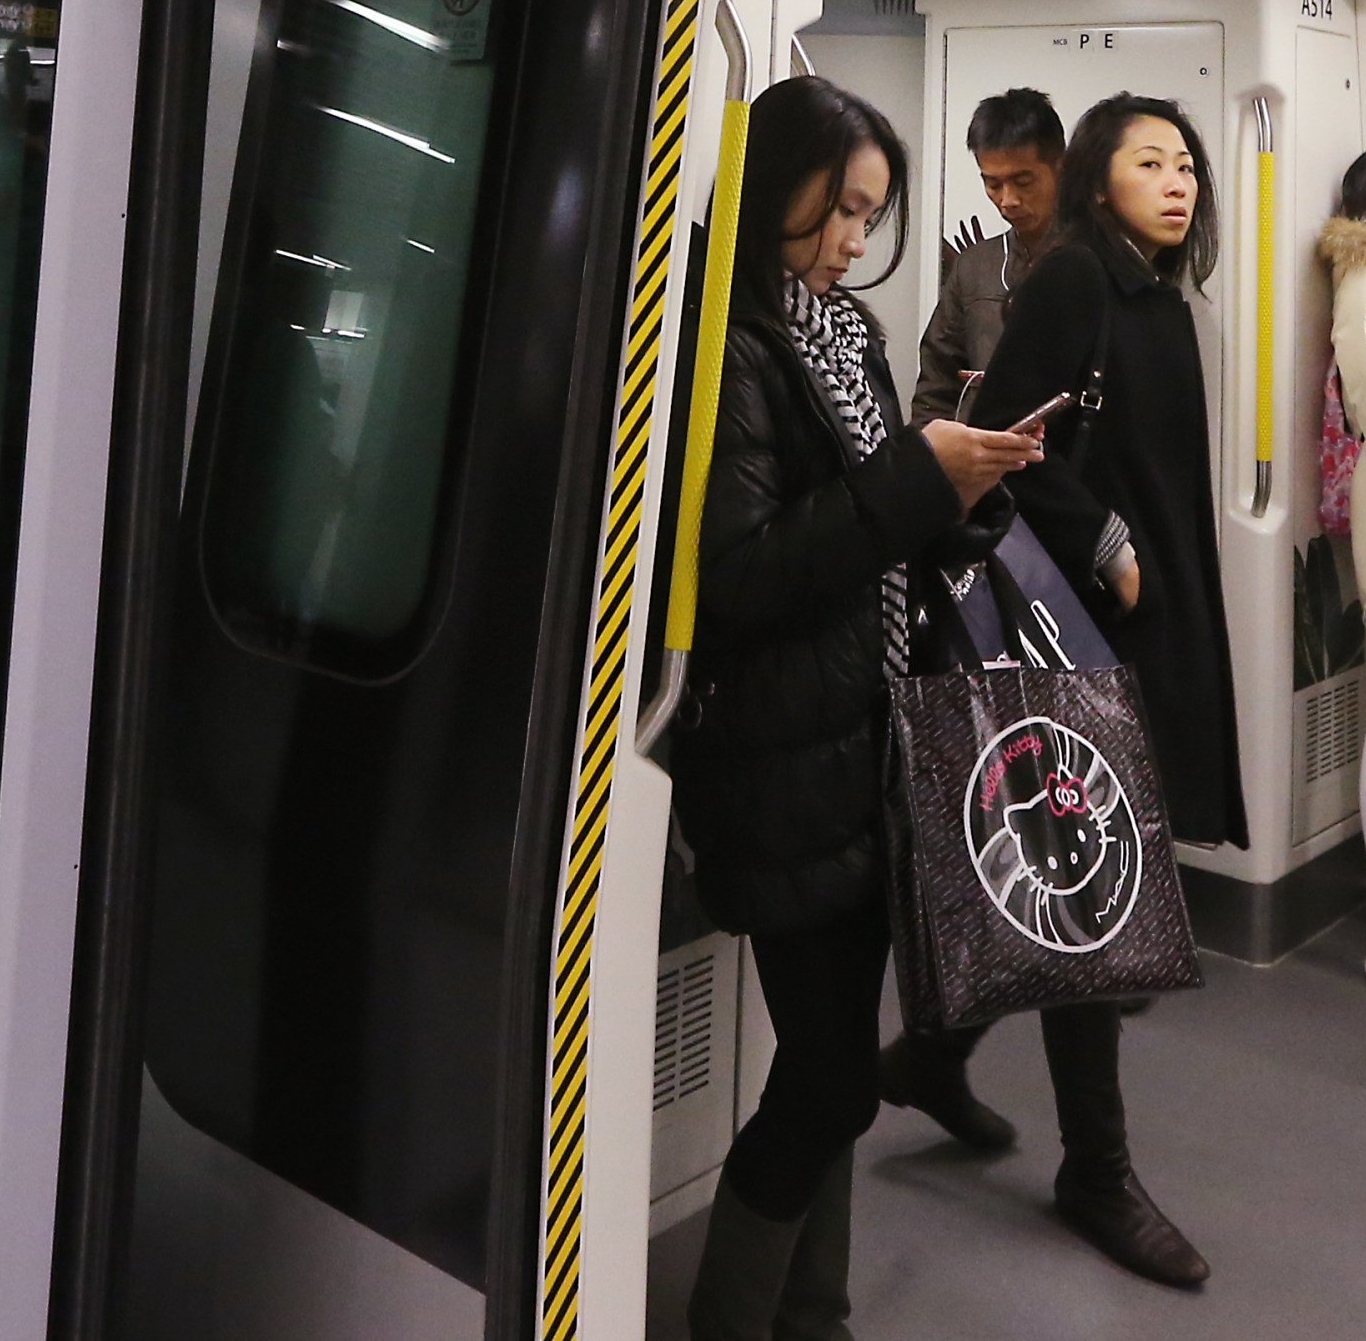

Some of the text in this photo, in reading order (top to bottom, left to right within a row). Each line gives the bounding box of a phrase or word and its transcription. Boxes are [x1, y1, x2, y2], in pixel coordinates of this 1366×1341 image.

[1079, 34, 1089, 49] P
[1104, 33, 1114, 49] E
[980, 733, 1044, 811] Hello Kitty
